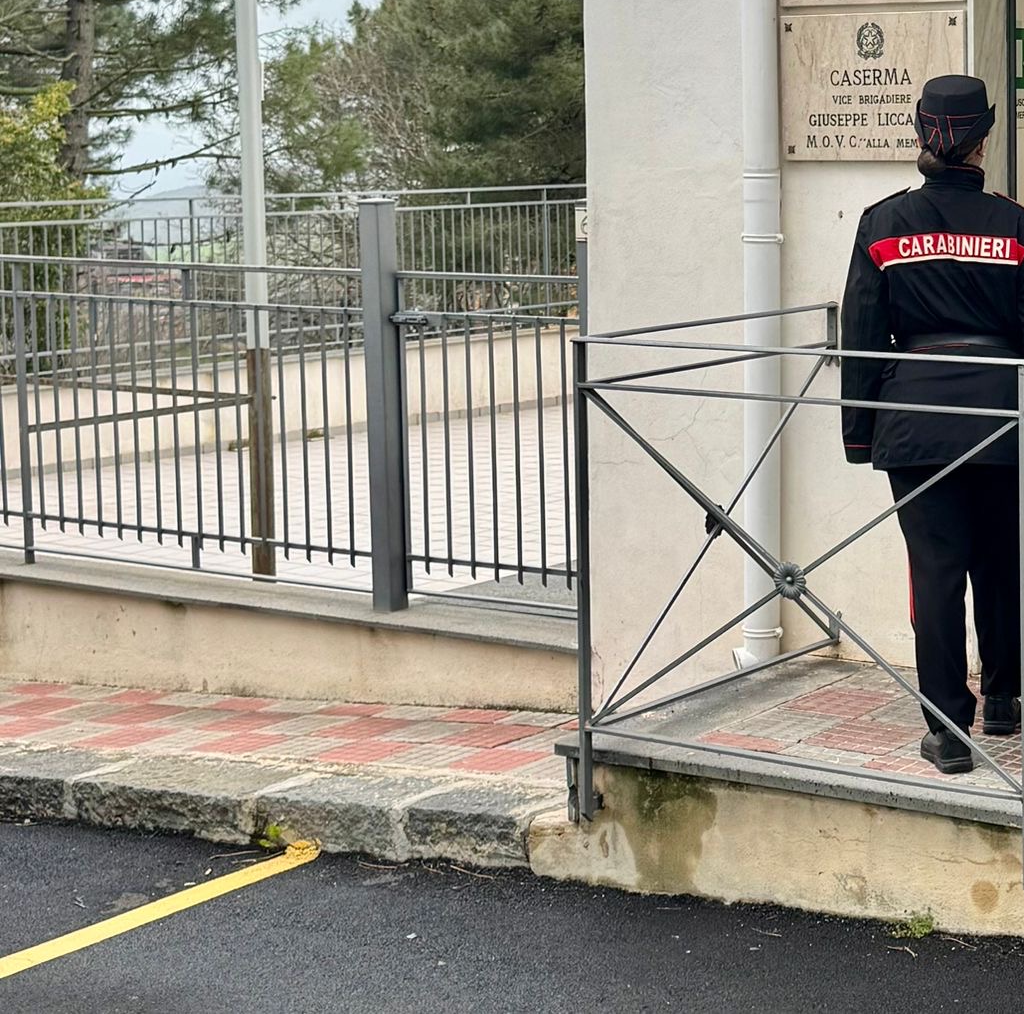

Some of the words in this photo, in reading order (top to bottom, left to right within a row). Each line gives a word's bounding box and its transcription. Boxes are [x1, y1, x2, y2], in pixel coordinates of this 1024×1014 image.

[830, 68, 912, 86] CASERMA
[832, 95, 852, 105] VICE
[859, 94, 911, 105] BRIGADIERE
[809, 113, 868, 127] GIUSEPPE
[899, 234, 1011, 259] CARABINIERI
